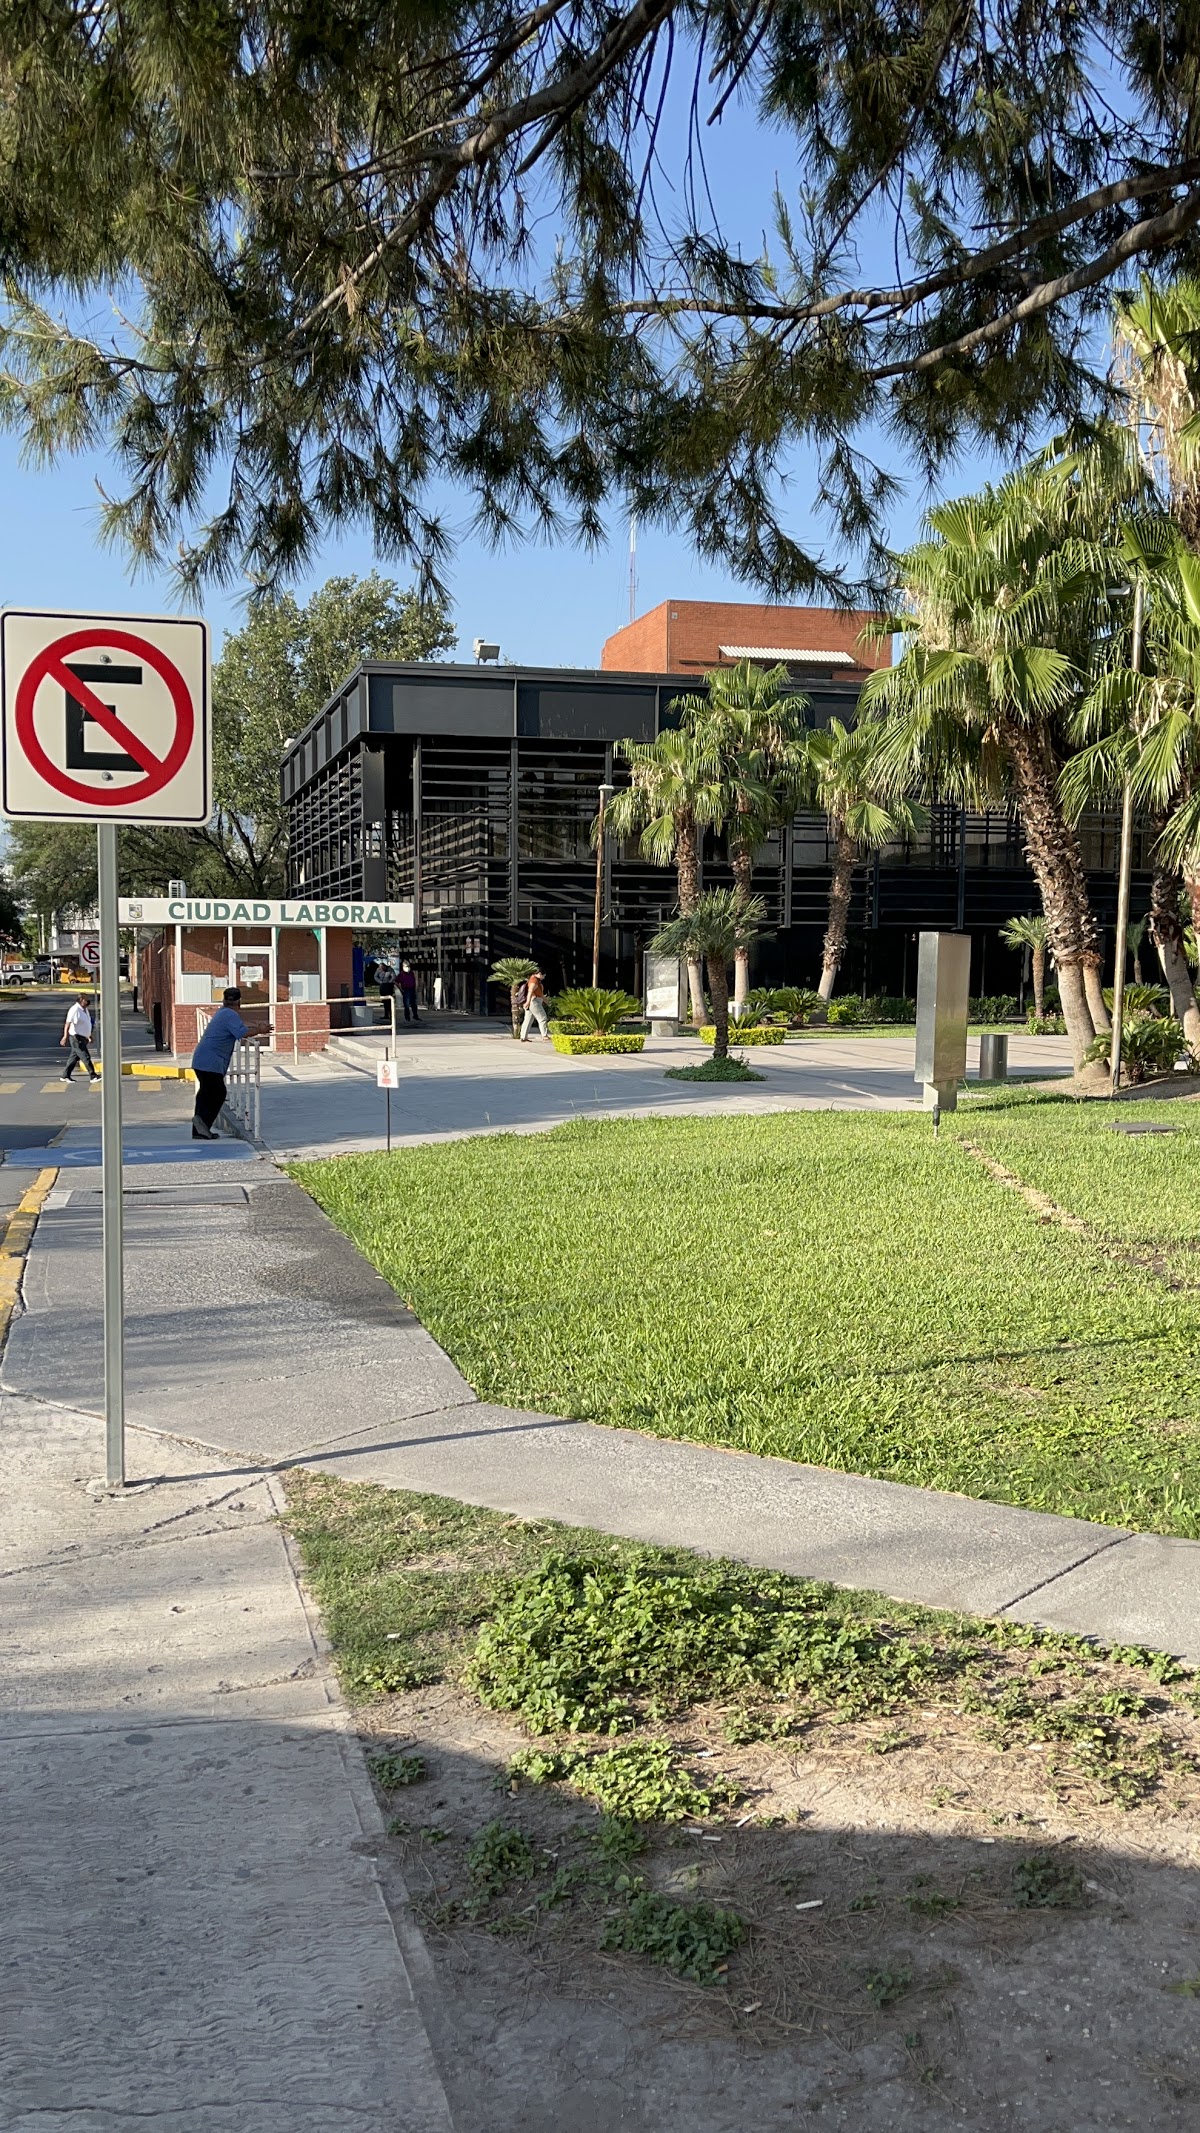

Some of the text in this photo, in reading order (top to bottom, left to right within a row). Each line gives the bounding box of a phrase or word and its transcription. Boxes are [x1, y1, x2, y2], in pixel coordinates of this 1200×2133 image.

[65, 663, 144, 772] E
[168, 902, 396, 924] CIUDAD LABORAL
